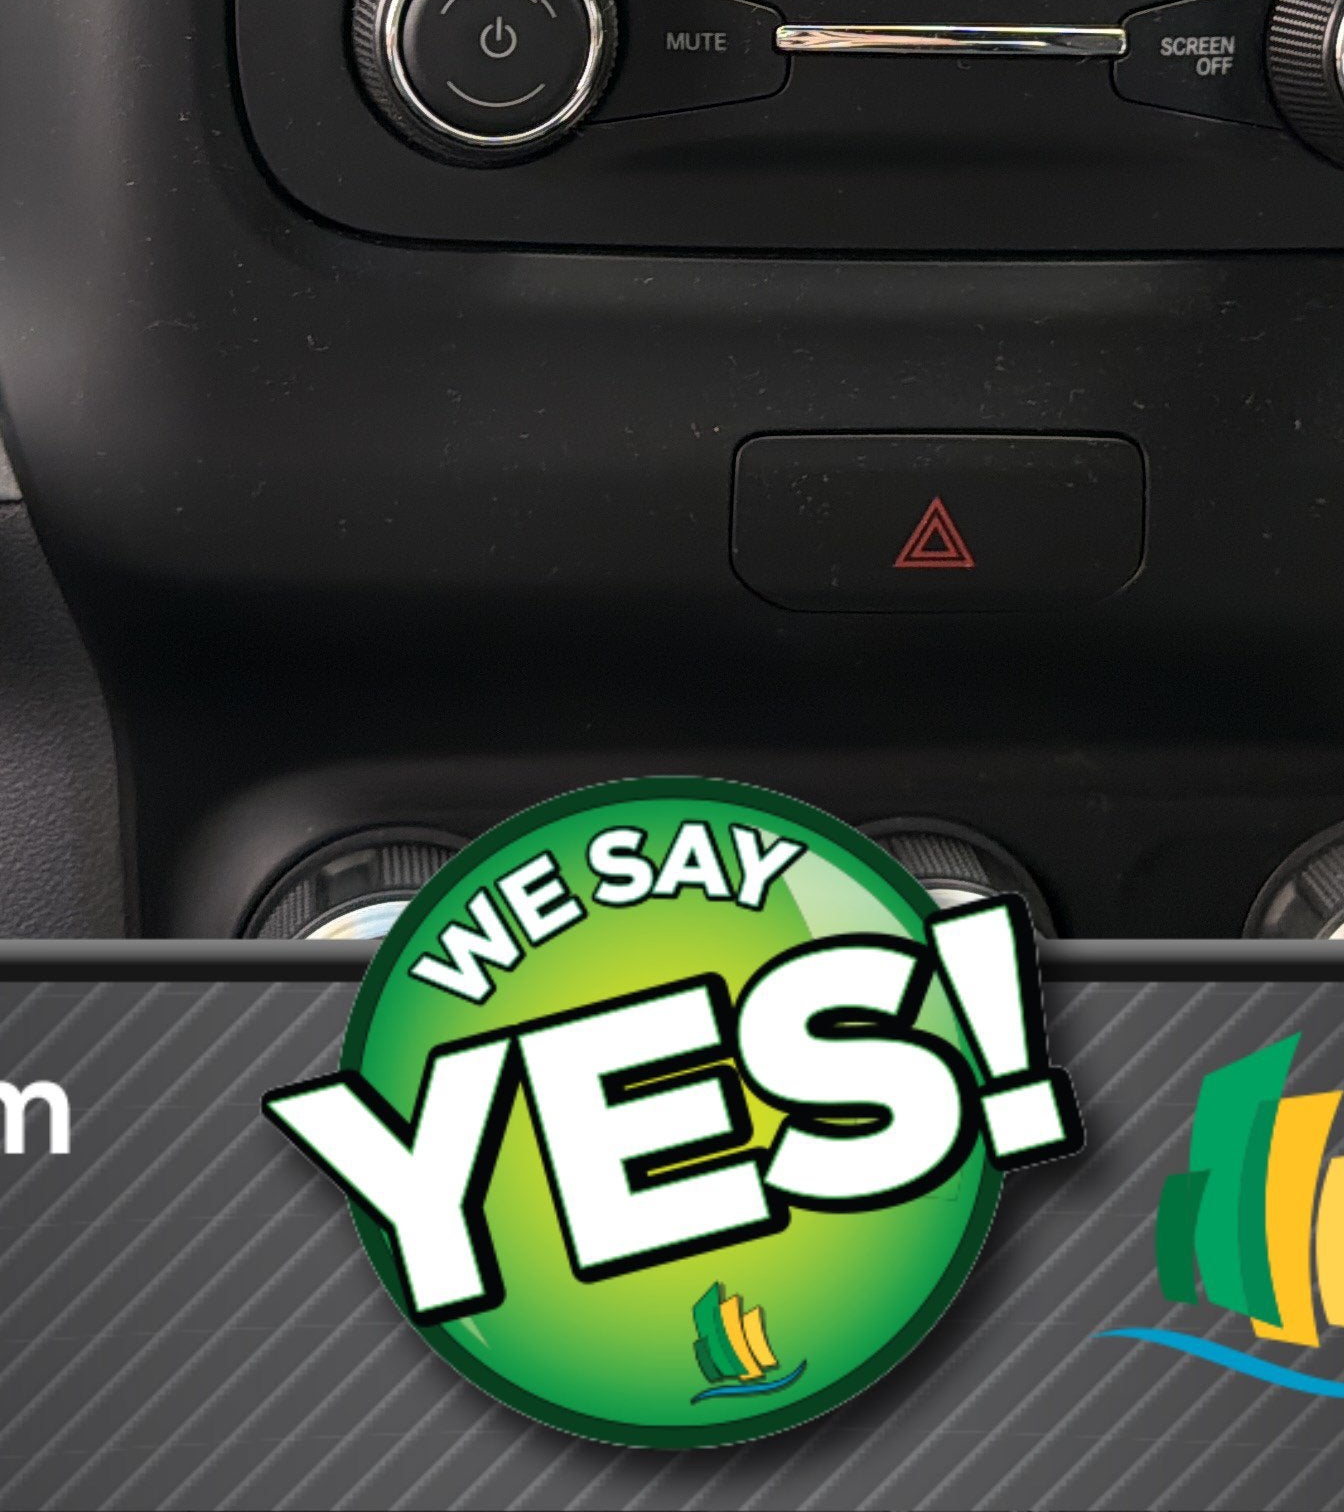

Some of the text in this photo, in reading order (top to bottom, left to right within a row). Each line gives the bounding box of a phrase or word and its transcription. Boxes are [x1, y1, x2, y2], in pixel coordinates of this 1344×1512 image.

[666, 31, 727, 52] MUTE
[1160, 36, 1235, 56] SCREEN
[1195, 56, 1233, 76] OFF
